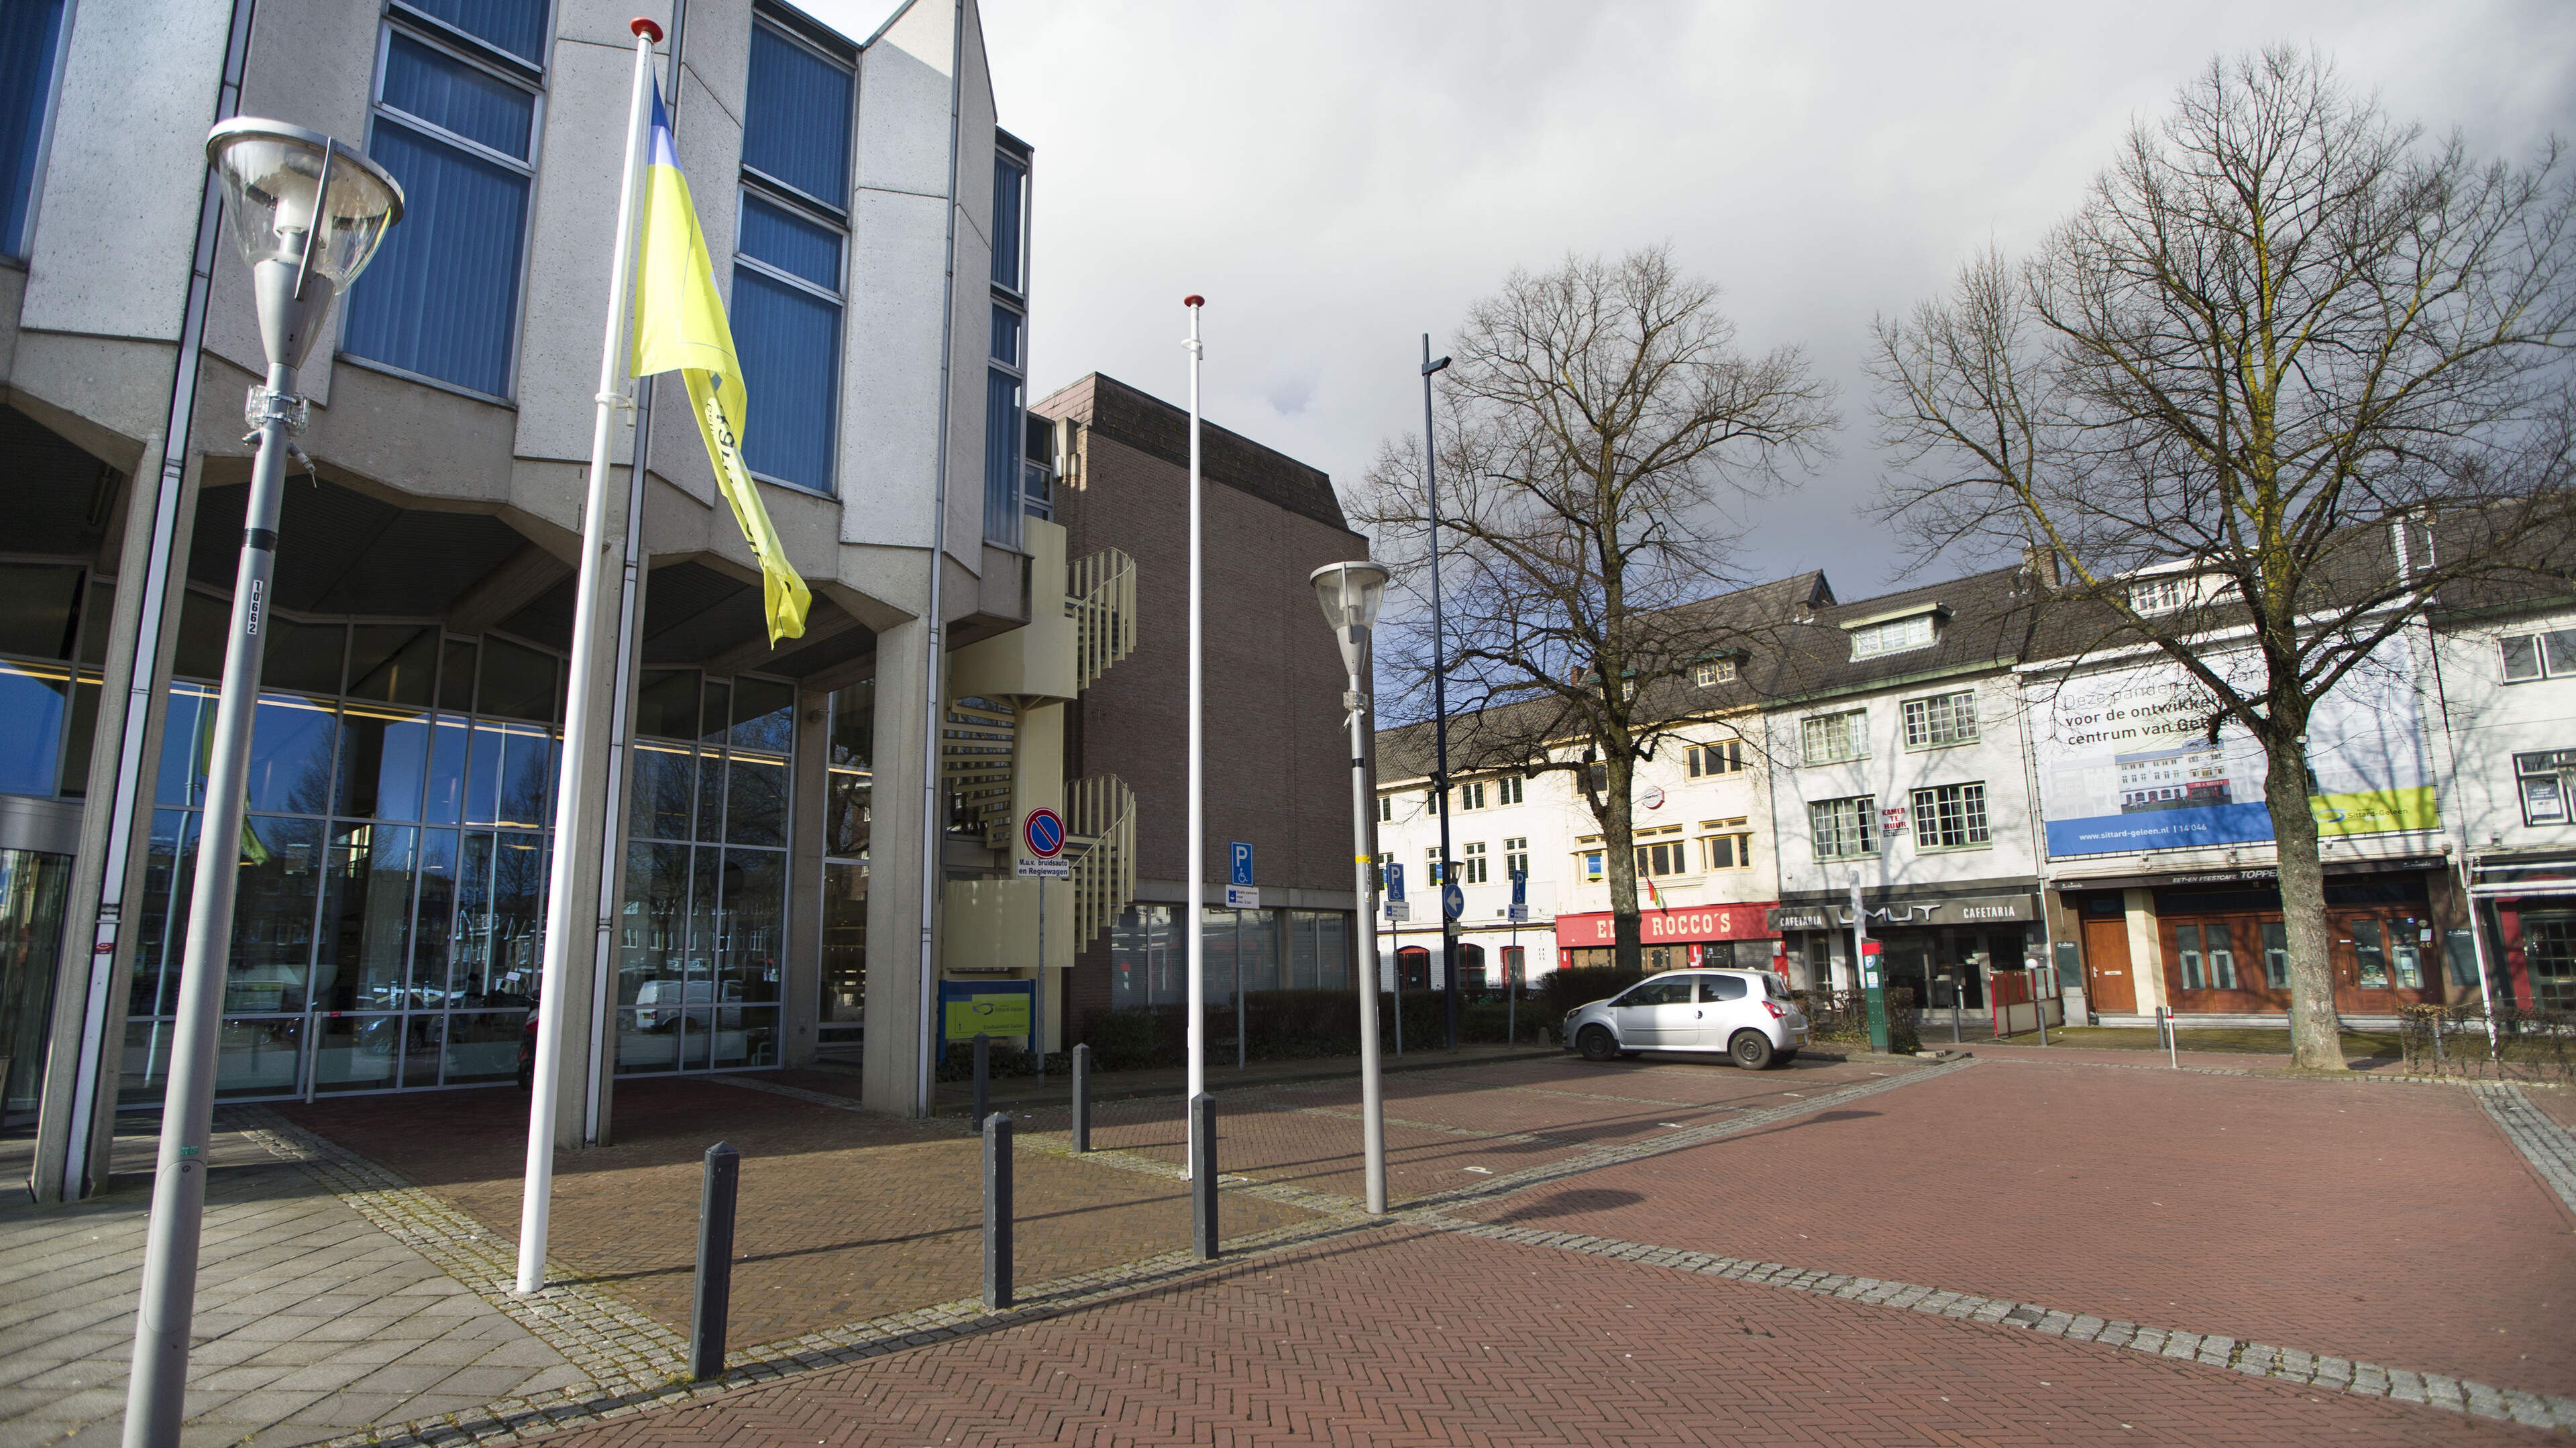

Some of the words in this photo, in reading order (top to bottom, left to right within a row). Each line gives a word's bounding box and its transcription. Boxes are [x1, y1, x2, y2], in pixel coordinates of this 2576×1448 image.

[249, 581, 260, 633] 10662
[2063, 693, 2105, 709] Deze
[2065, 713, 2101, 727] voor
[2106, 709, 2125, 721] de
[2068, 728, 2137, 746] centrum
[2142, 723, 2172, 736] van
[1882, 807, 1905, 816] KAMER
[2348, 809, 2408, 820] Sittard-Geleen
[1884, 822, 1906, 830] HUUR
[2079, 826, 2169, 840] www.sittard-geleen.nl
[2191, 823, 2207, 832] 046
[1236, 846, 1248, 867] P
[1028, 868, 1068, 876] Regiewagen
[1391, 867, 1401, 885] P
[1516, 873, 1523, 889] P
[1963, 905, 2015, 919] CAFETARIA
[1780, 915, 1823, 927] CAFETARIA
[1866, 956, 1873, 966] P
